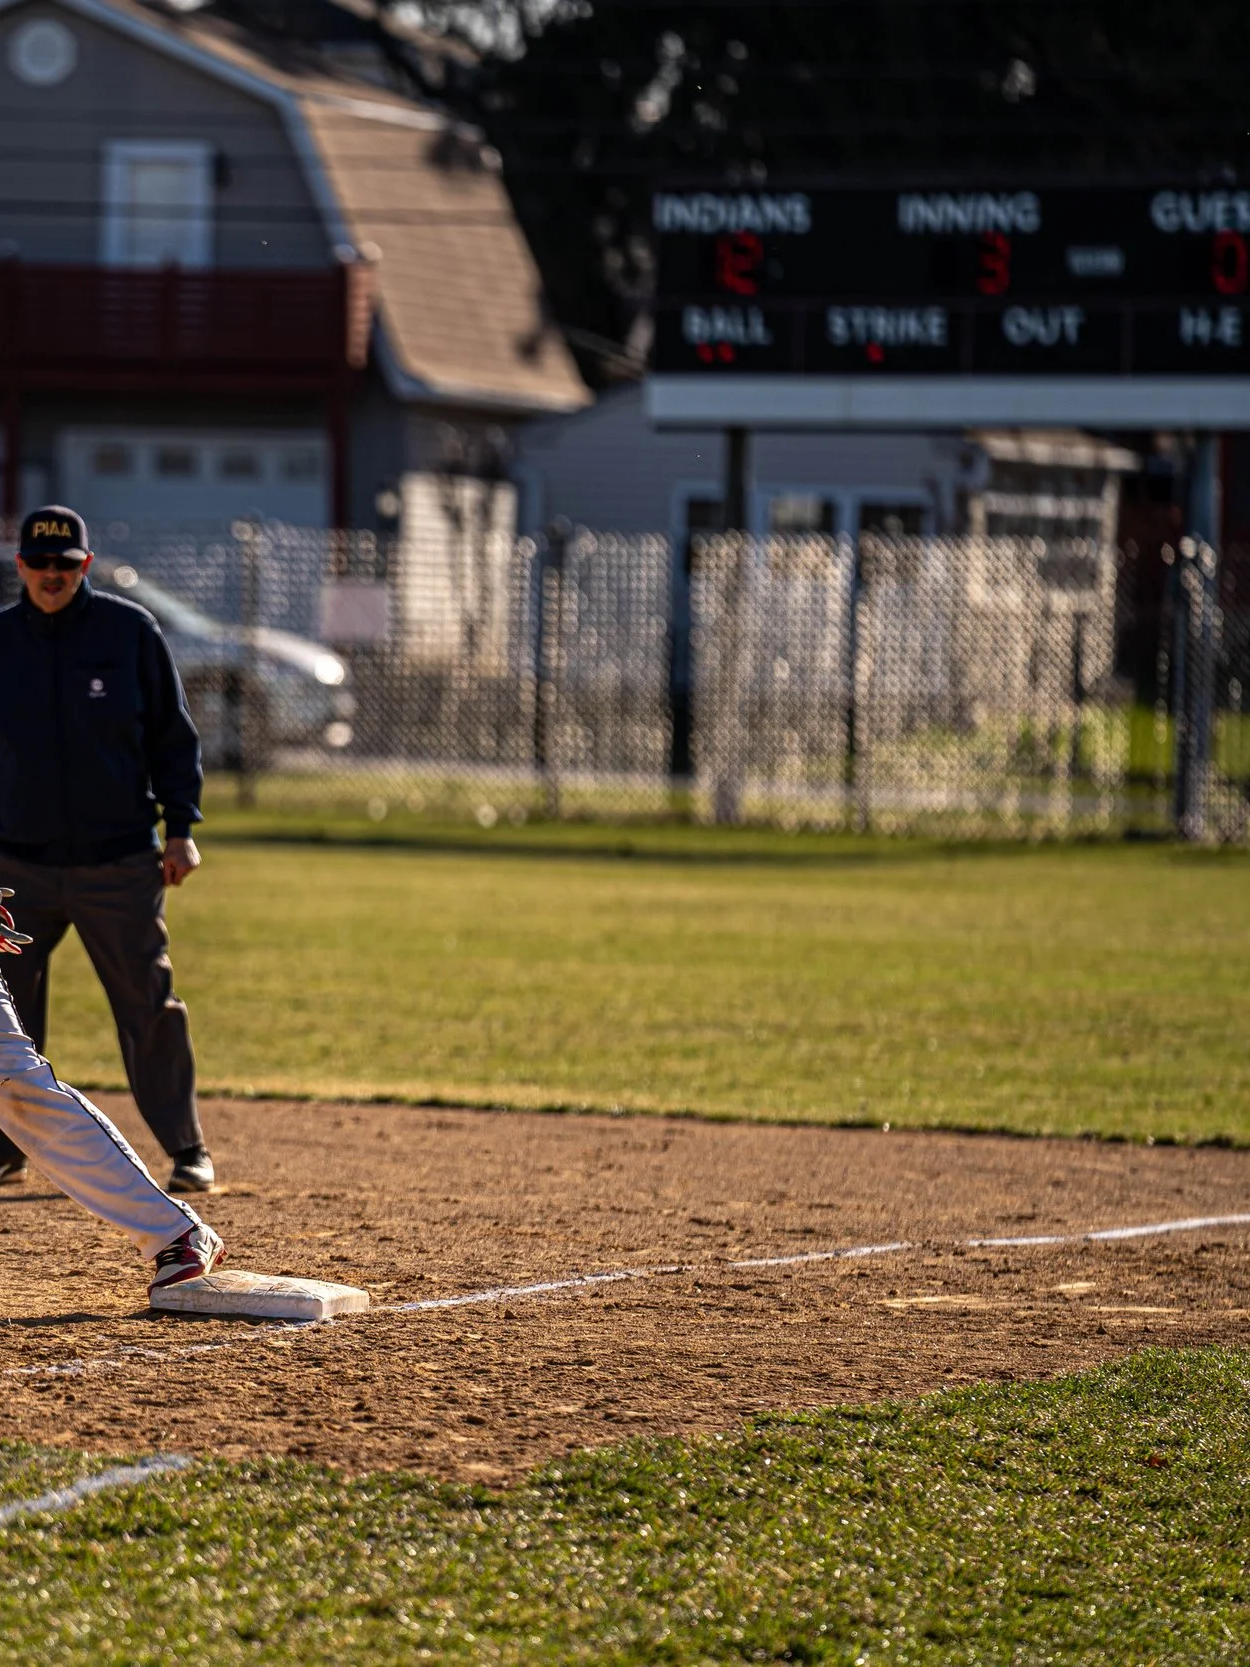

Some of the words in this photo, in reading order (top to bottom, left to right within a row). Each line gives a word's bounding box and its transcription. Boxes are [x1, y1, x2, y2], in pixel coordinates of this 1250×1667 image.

[654, 193, 812, 234] INDIANS
[897, 193, 1041, 233] INNING
[975, 231, 1012, 296] 3
[682, 305, 773, 346] BALL
[826, 305, 950, 346] STRIKE
[1002, 304, 1084, 346] OUT
[33, 520, 72, 538] PIAA
